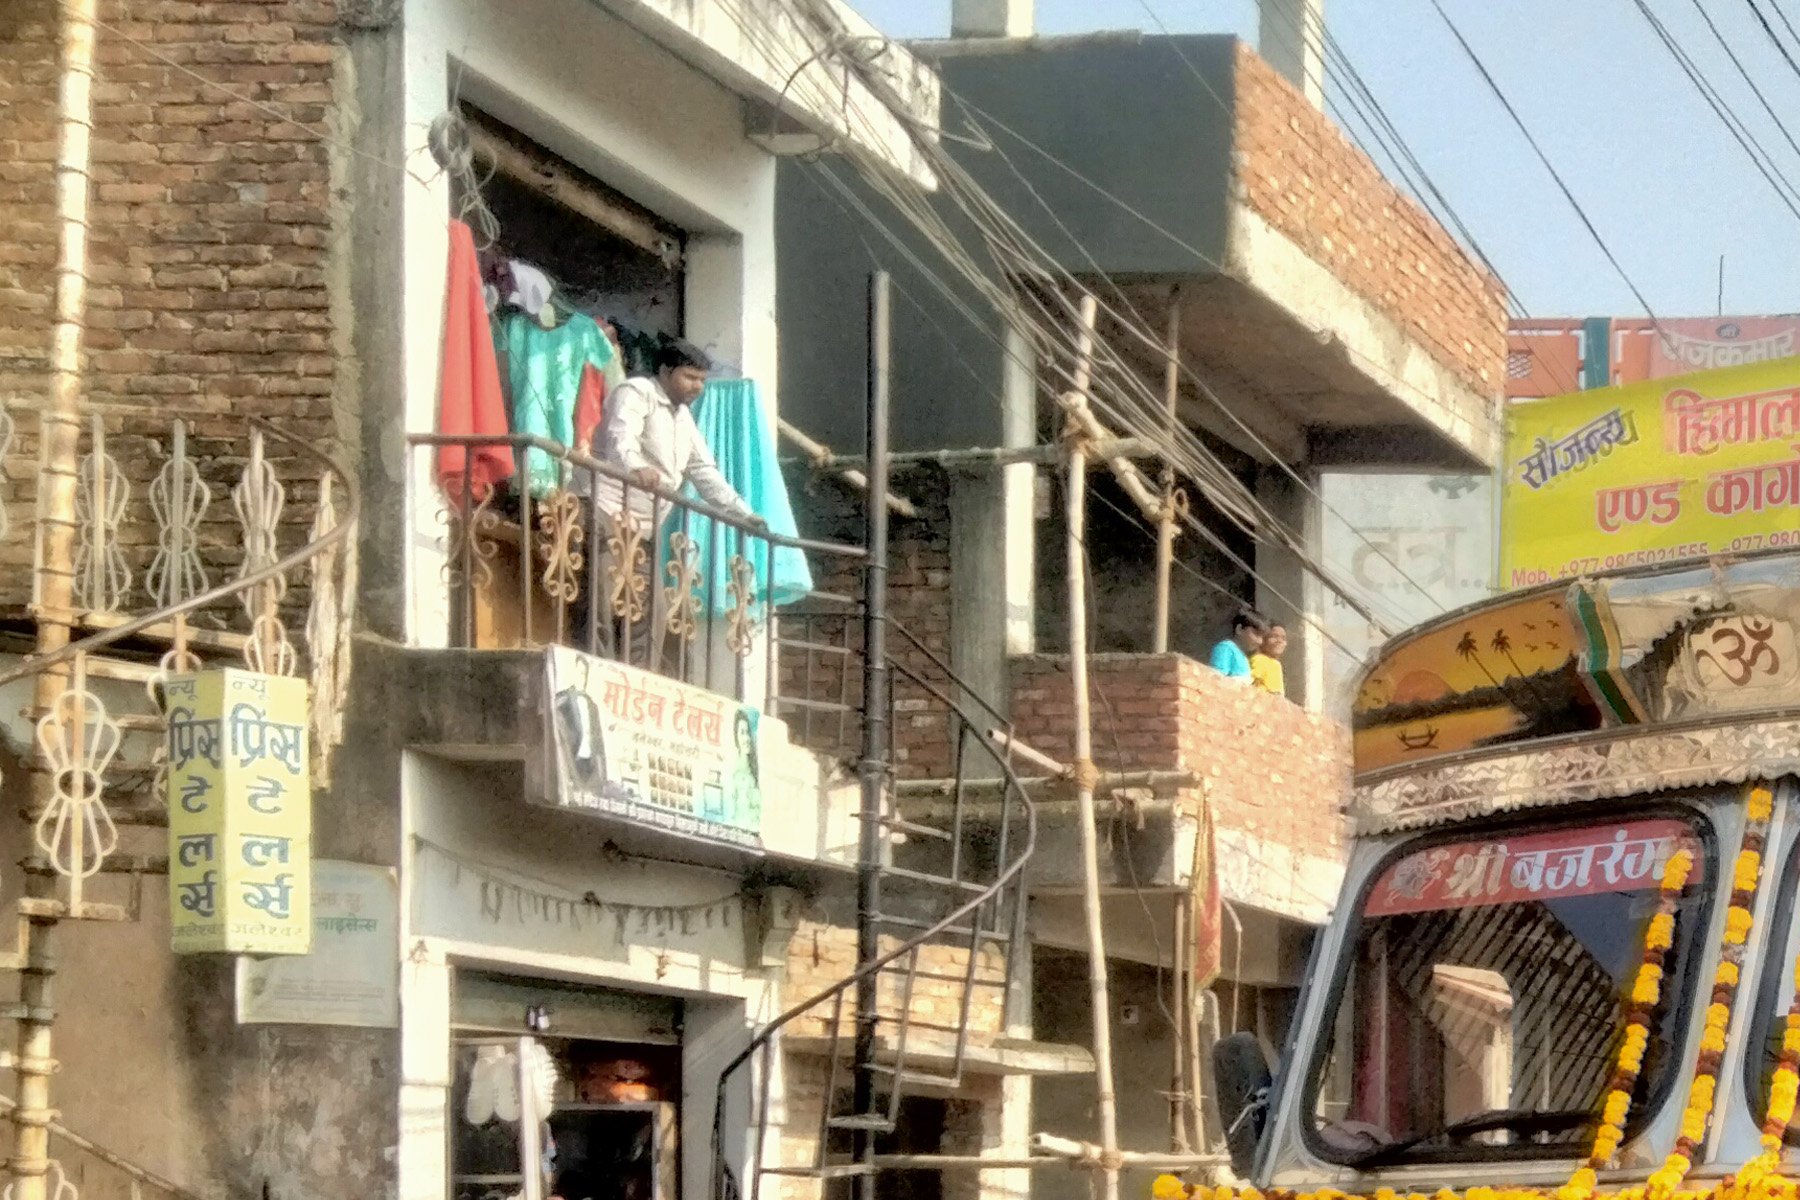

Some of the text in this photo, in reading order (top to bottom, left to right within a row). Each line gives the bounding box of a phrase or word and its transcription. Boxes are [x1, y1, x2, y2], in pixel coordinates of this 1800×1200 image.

[1594, 478, 1690, 533] एण्ड
[1441, 829, 1679, 900] श्री बजरंग
